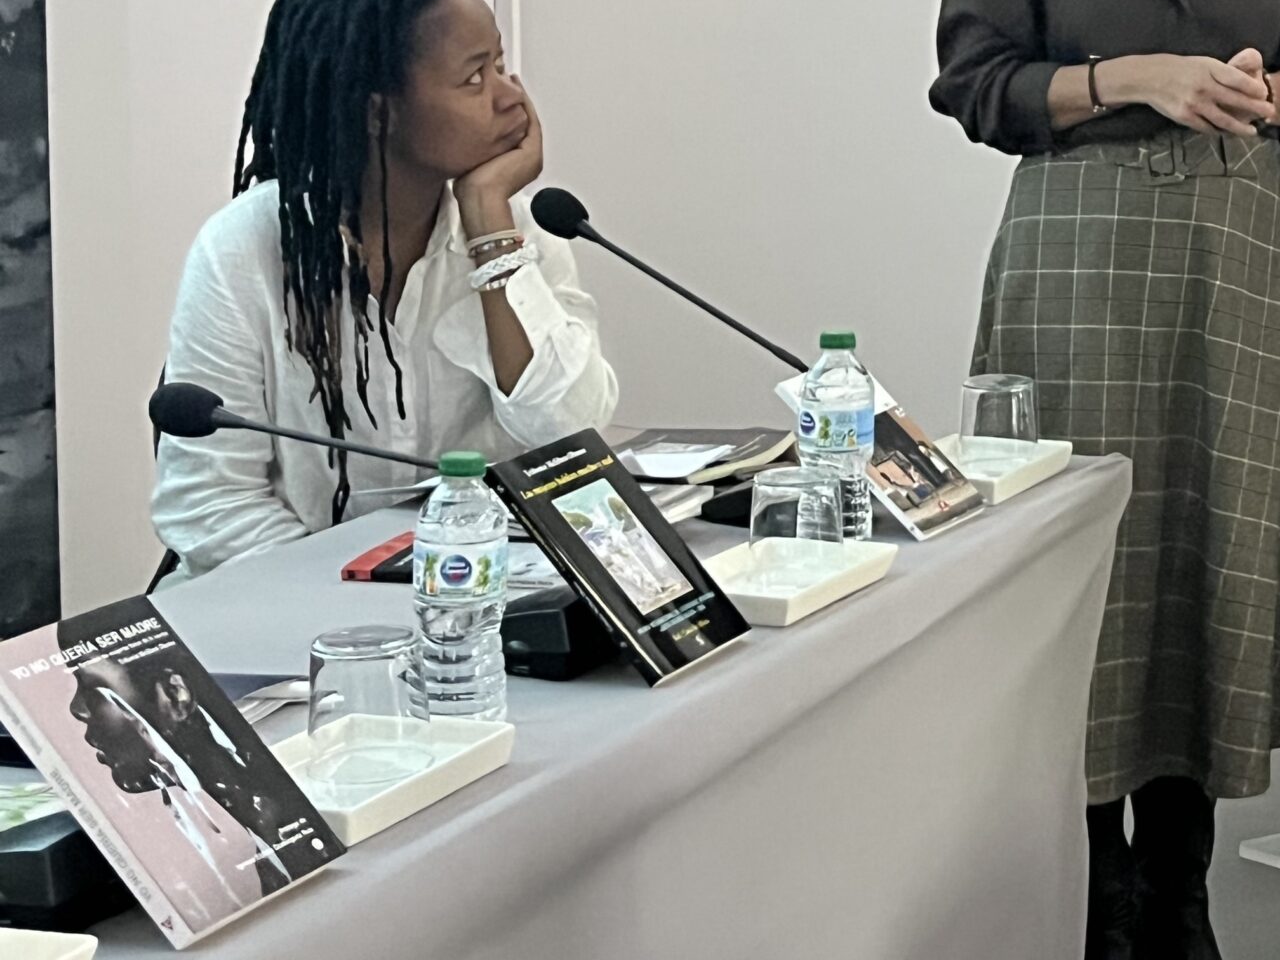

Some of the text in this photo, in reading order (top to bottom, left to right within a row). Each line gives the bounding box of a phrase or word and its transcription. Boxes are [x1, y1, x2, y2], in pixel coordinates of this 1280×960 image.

[10, 665, 31, 680] YO
[28, 658, 51, 675] NO
[49, 640, 99, 667] QUERÍA
[95, 630, 123, 649] SER
[120, 617, 162, 640] MADRE
